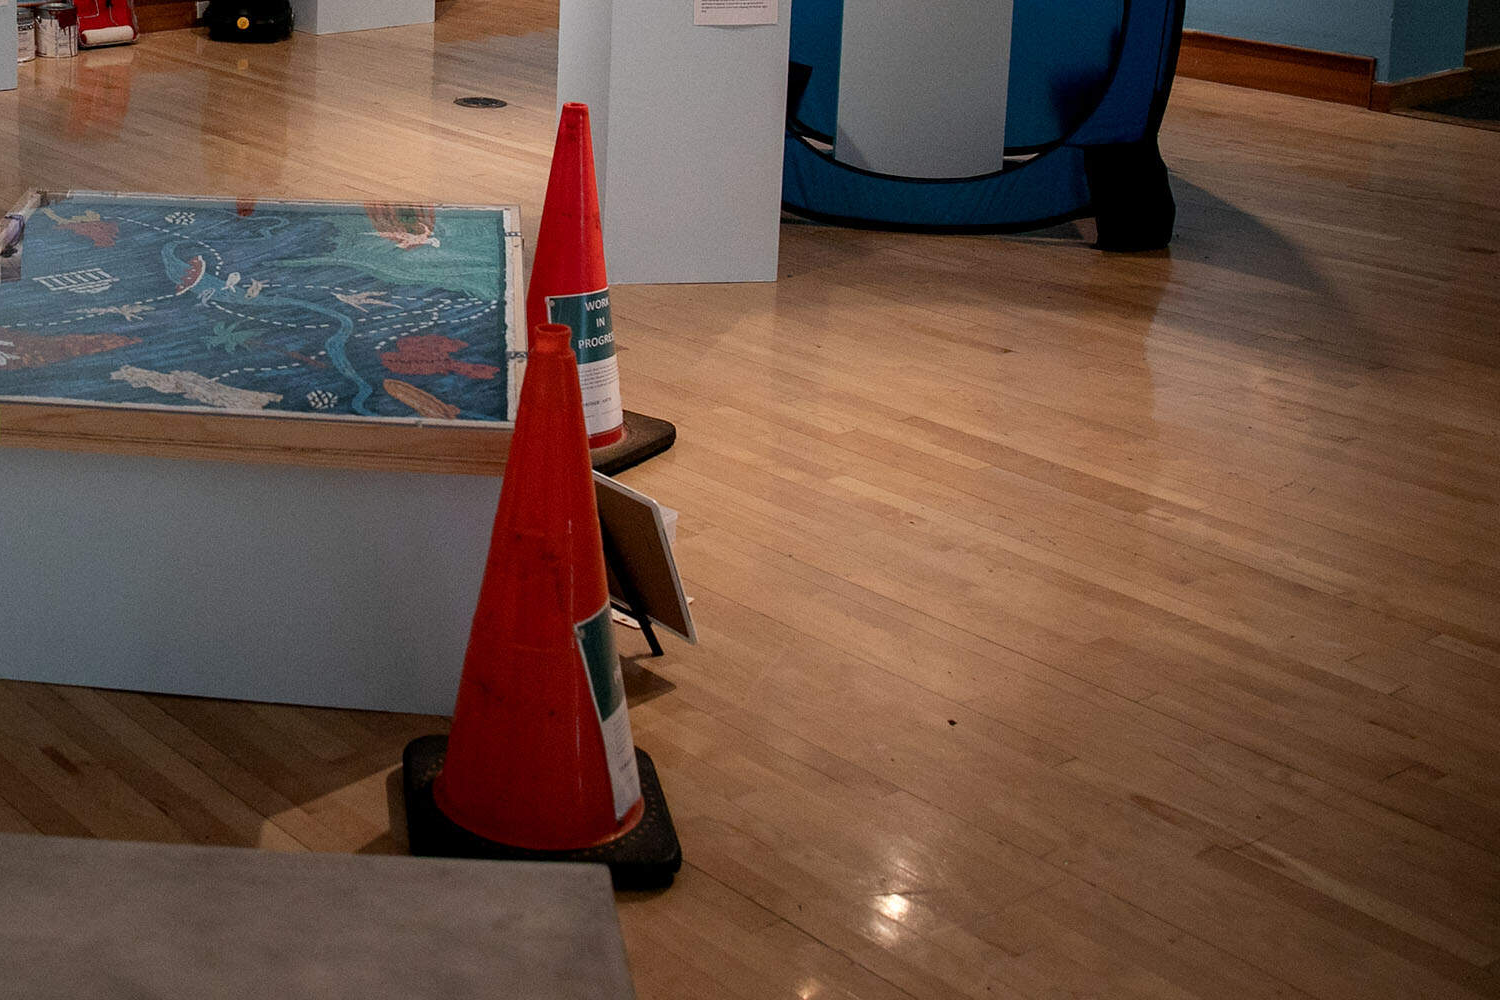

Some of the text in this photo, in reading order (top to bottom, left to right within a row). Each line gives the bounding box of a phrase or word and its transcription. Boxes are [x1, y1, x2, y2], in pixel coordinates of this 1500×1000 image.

[585, 297, 610, 312] WORK
[595, 317, 606, 328] IN
[578, 332, 614, 350] PROGRE
